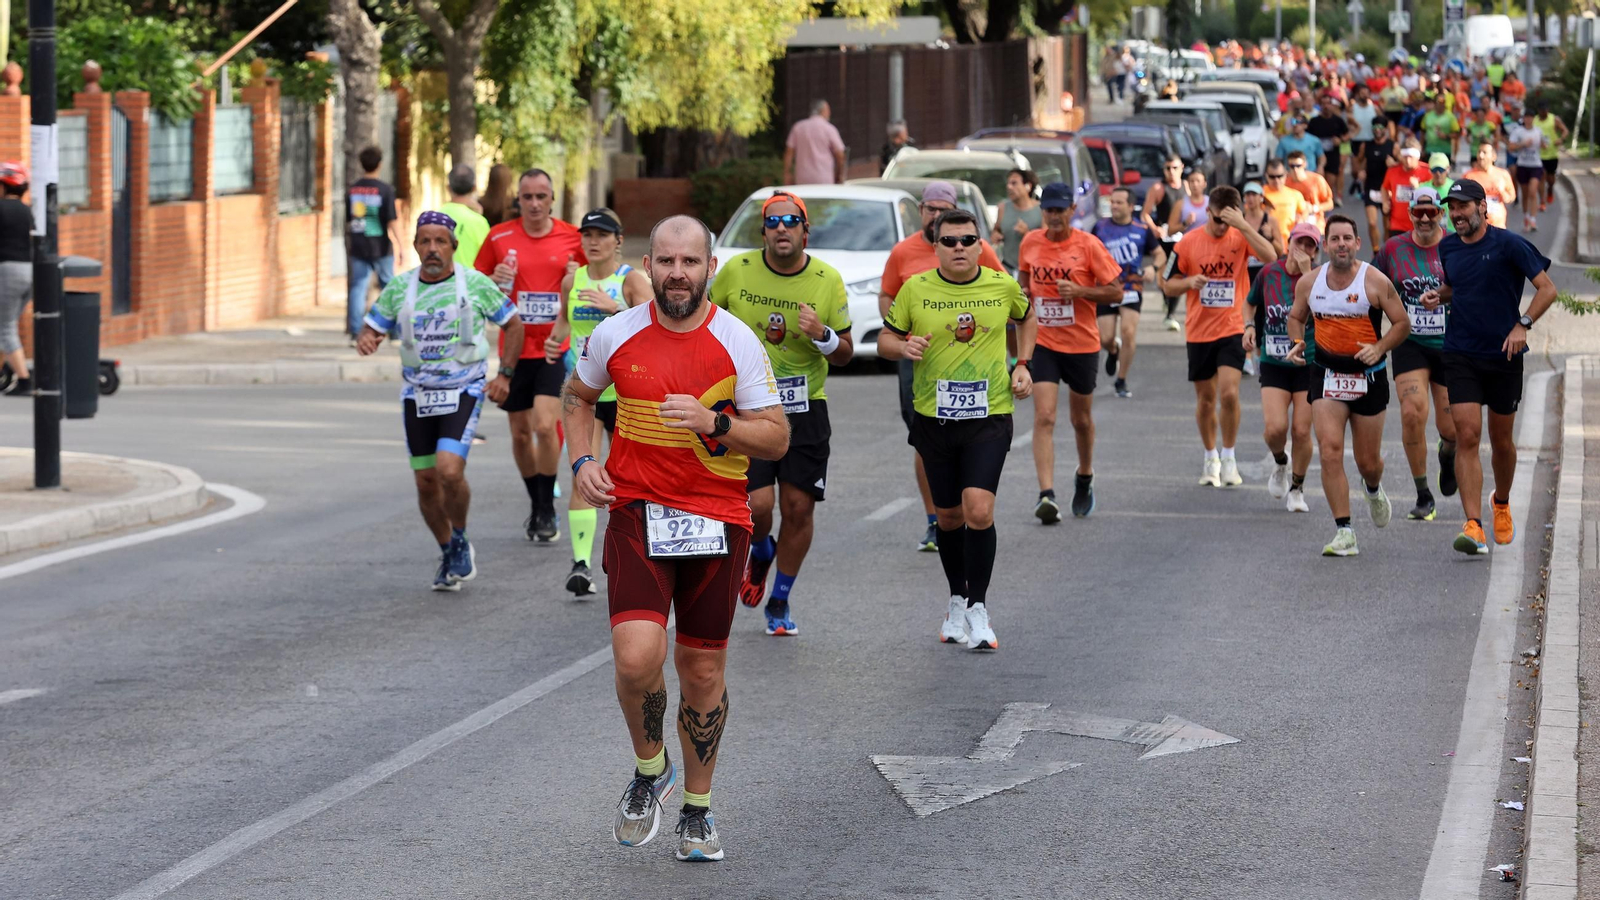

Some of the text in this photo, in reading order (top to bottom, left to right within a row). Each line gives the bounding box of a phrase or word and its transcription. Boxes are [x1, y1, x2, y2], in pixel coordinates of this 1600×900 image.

[1207, 289, 1226, 298] 662
[526, 303, 554, 313] 1095
[923, 298, 1002, 311] Paparunners
[1043, 307, 1064, 317] 333
[1415, 316, 1435, 325] 614
[1335, 380, 1357, 390] 139
[424, 392, 447, 404] 733
[949, 394, 976, 407] 793
[667, 516, 706, 539] 929
